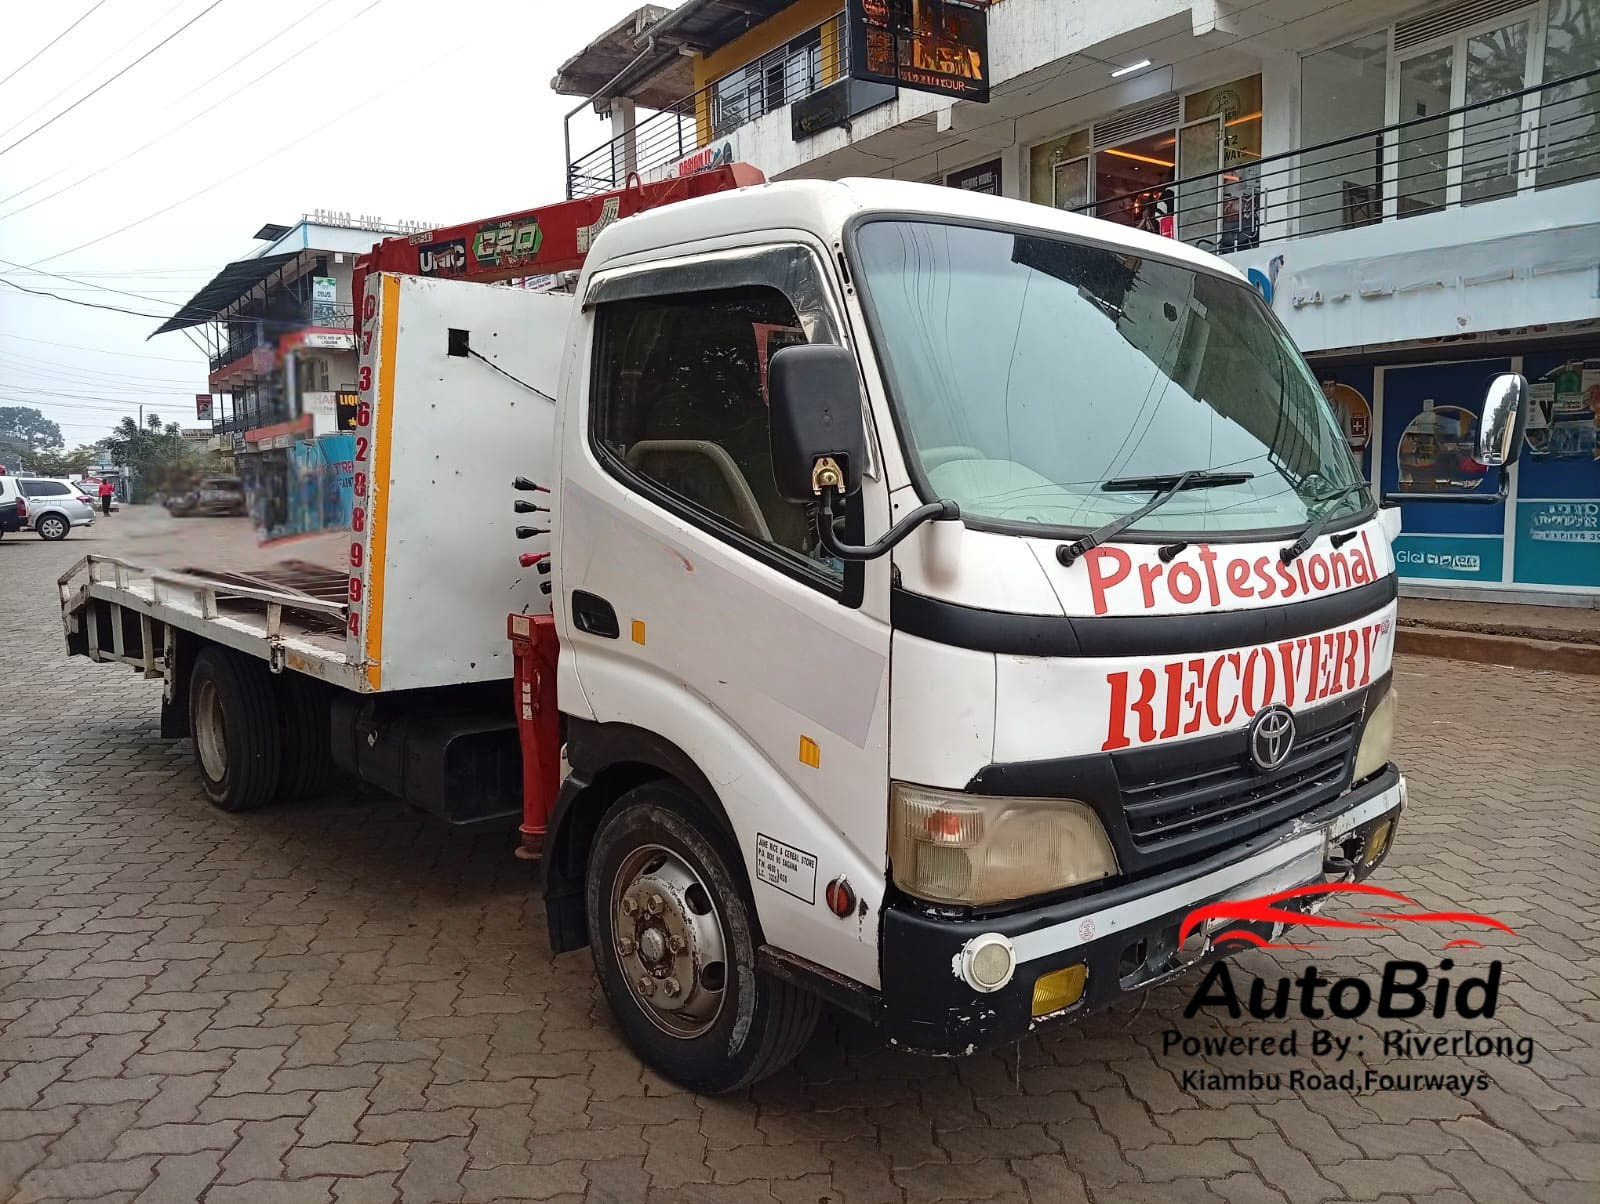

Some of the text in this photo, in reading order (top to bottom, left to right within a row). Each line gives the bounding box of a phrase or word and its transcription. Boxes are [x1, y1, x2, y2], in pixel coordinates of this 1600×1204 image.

[360, 213, 387, 232] CHIE
[420, 244, 465, 272] UNIC
[1083, 530, 1379, 615] Professional
[1101, 623, 1381, 752] RECOVERY
[785, 849, 799, 862] CEREAL
[801, 856, 814, 868] STORE
